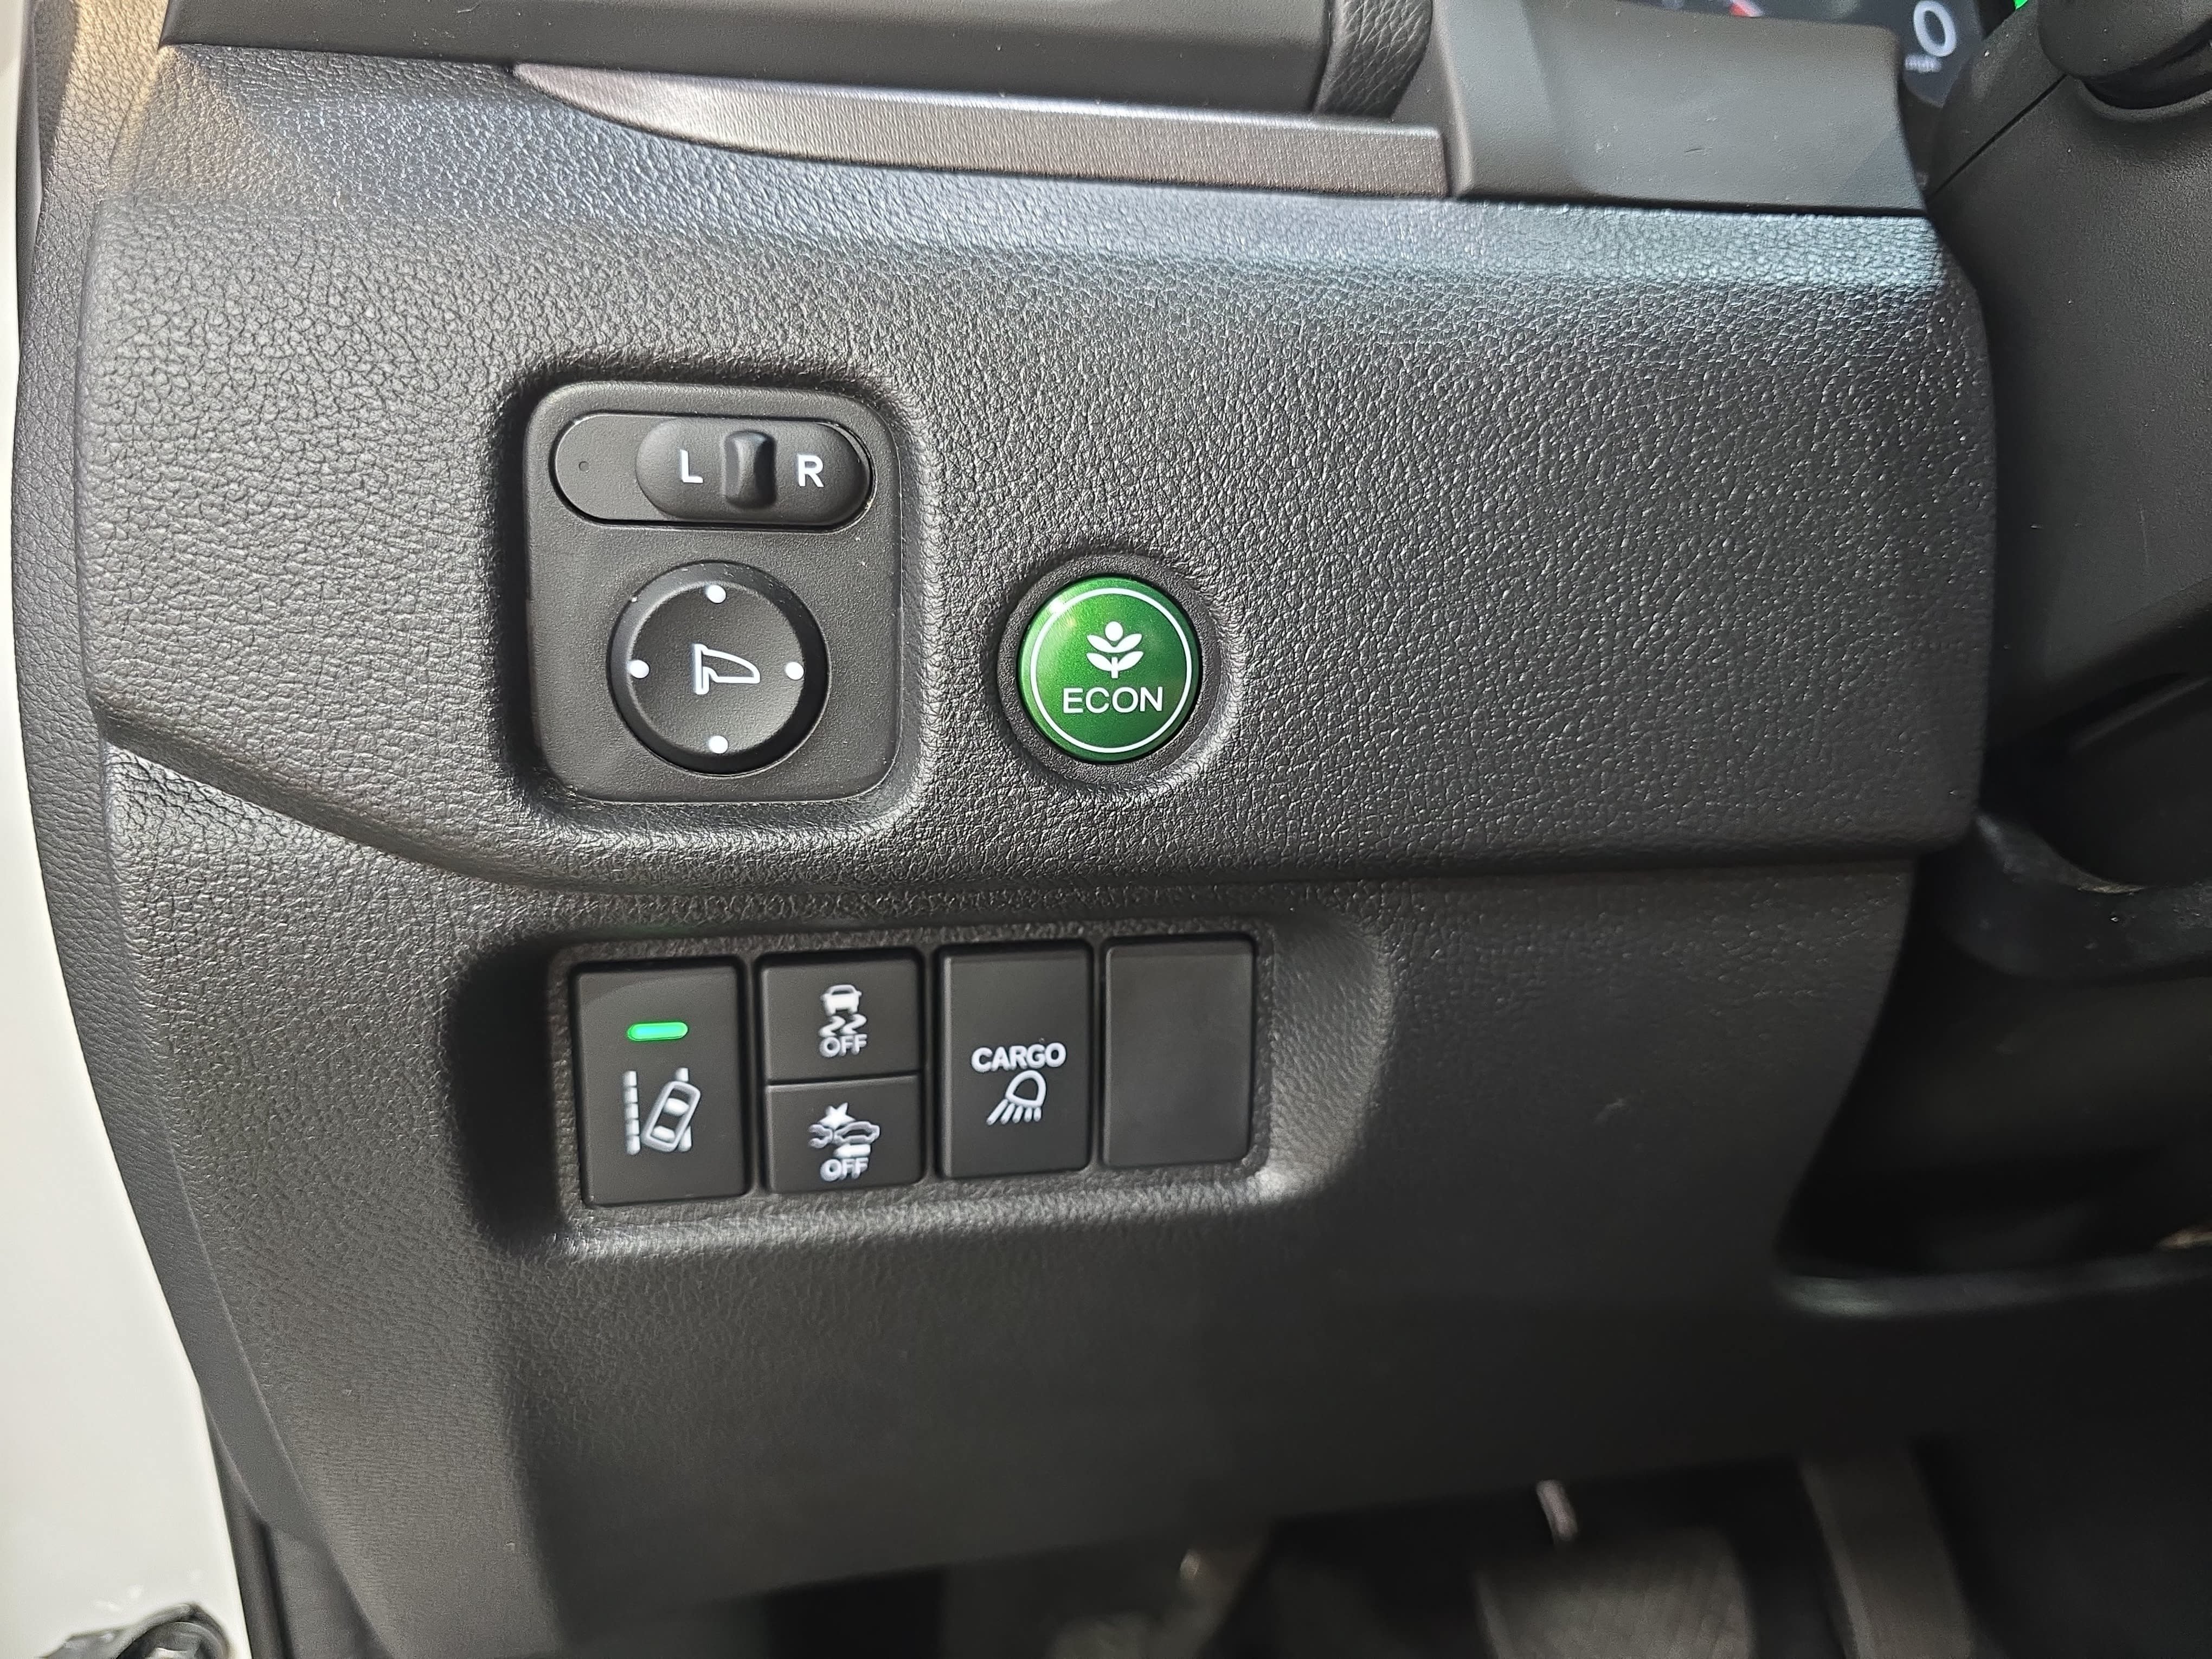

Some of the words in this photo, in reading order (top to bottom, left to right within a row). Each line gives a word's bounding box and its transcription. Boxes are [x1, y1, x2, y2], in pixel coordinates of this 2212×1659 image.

[1913, 1, 1956, 57] 0
[680, 449, 703, 483] L
[798, 454, 824, 487] R
[1063, 686, 1163, 713] ECON
[819, 1033, 867, 1058] OFF
[971, 1042, 1066, 1072] CARGO
[820, 1157, 869, 1181] OFF
